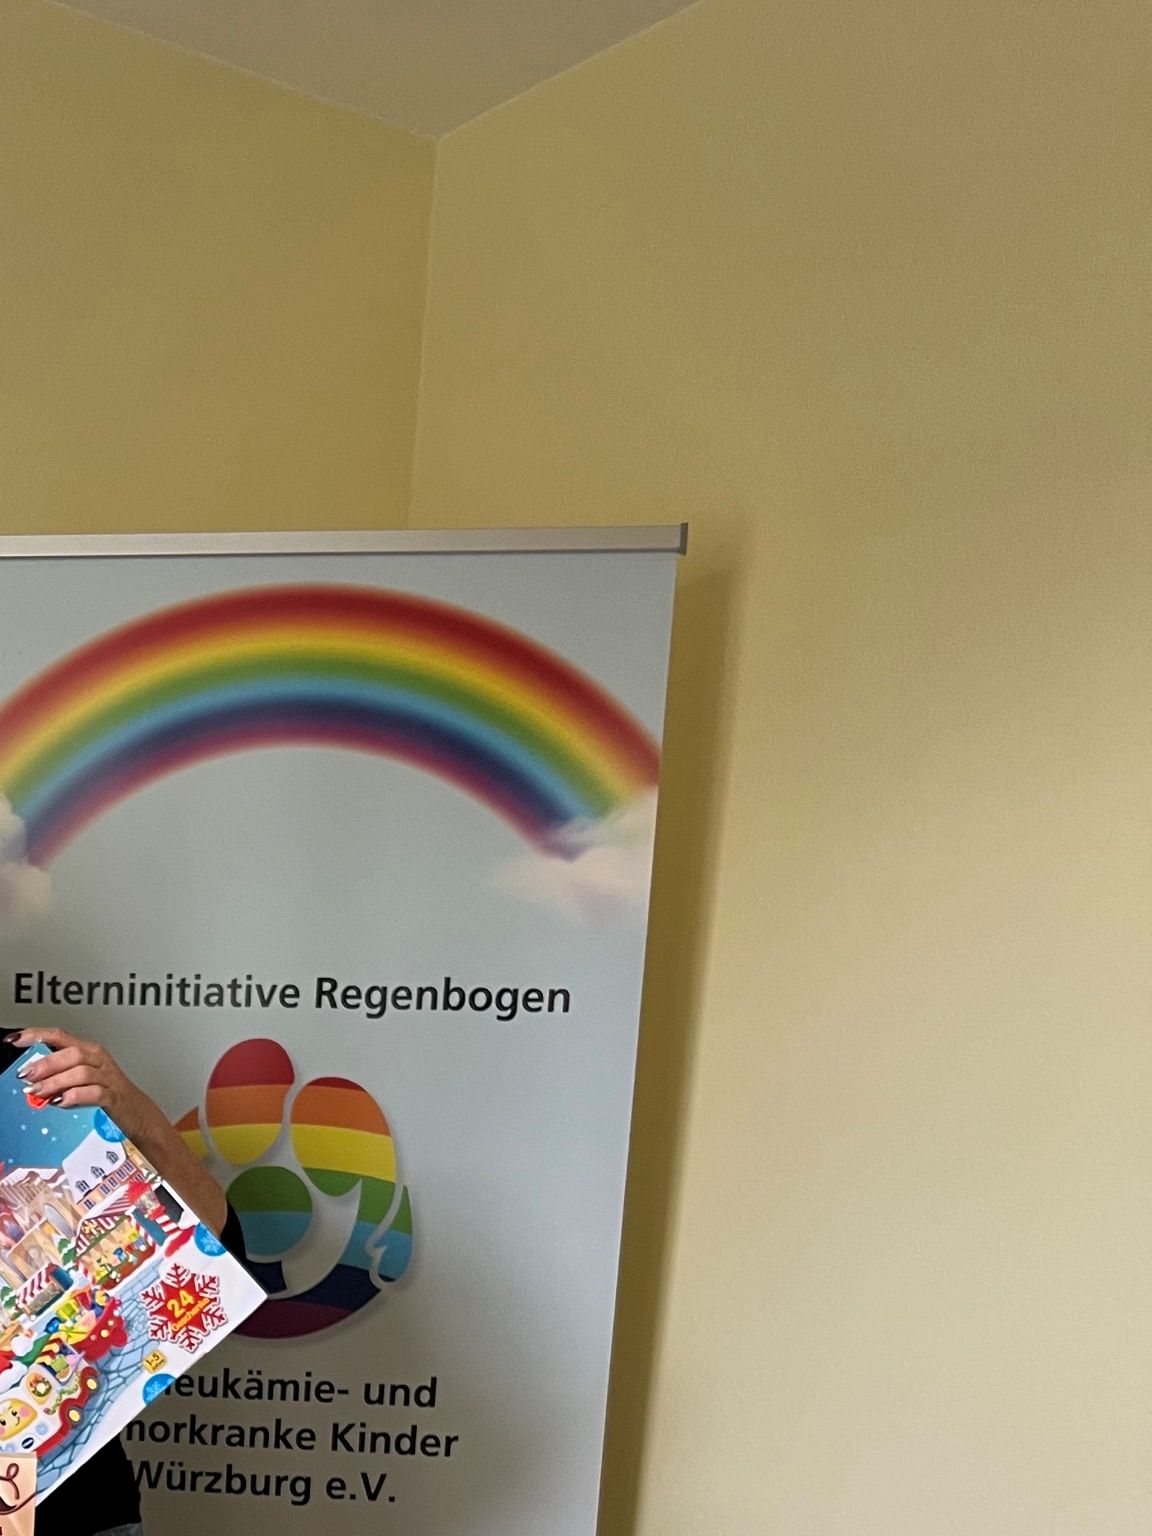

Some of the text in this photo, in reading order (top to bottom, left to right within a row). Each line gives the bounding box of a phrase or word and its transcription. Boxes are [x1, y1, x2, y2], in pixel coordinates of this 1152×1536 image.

[14, 972, 571, 1020] Elterninitiative Regenbogen
[166, 1289, 195, 1319] 24
[364, 1376, 437, 1408] und
[331, 1422, 459, 1457] Kinder
[134, 1459, 396, 1506] Würzburg e.V.
